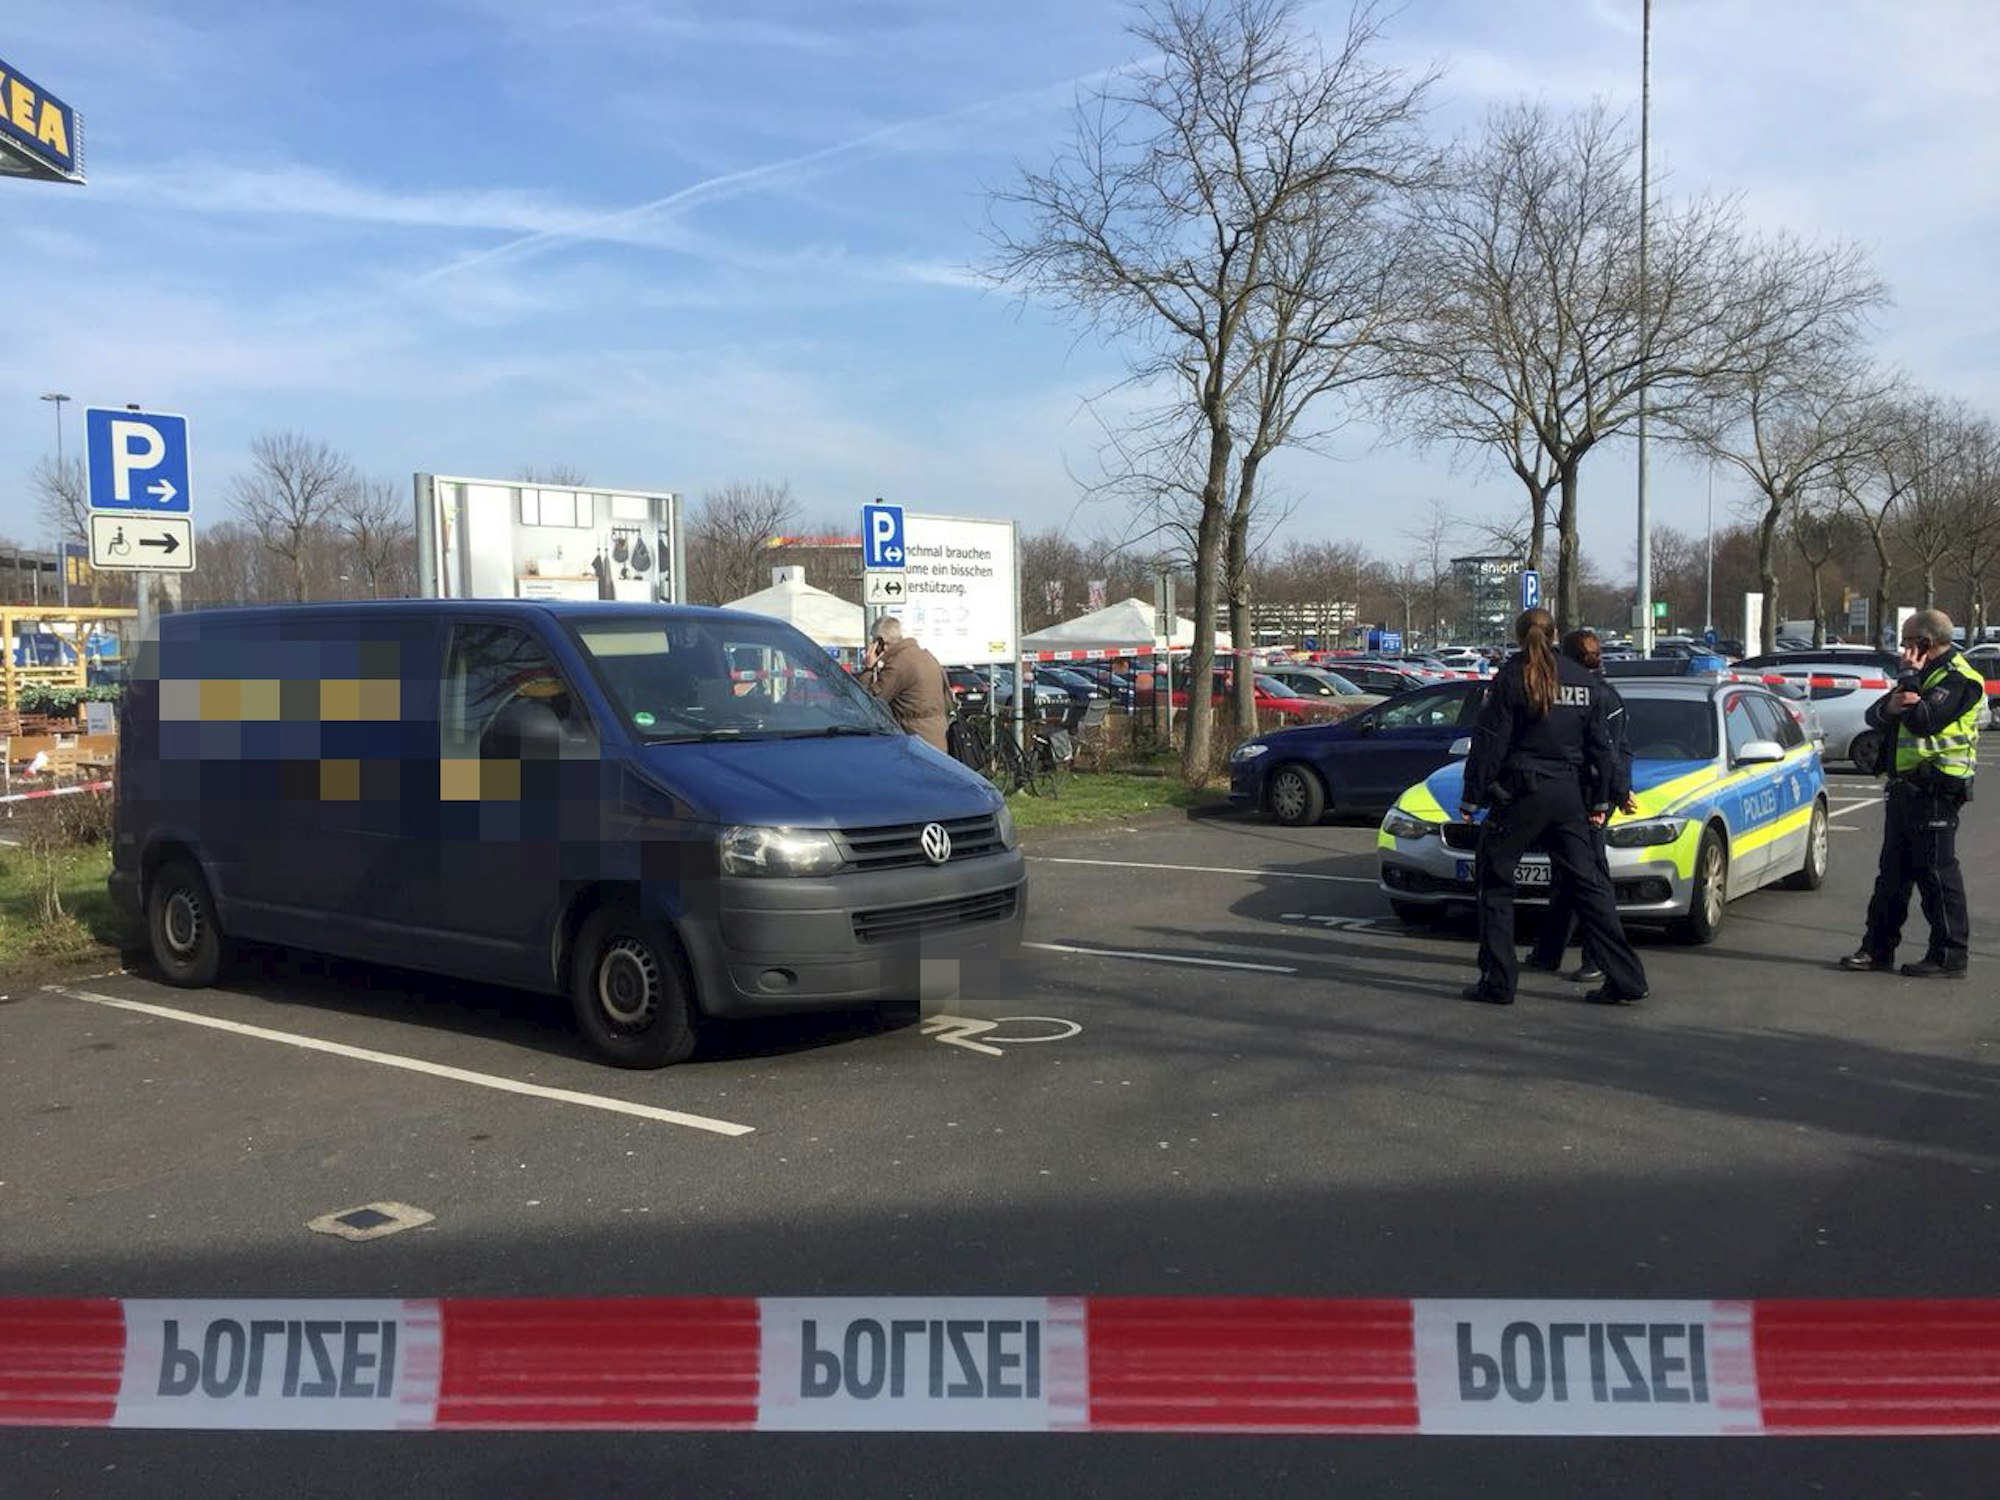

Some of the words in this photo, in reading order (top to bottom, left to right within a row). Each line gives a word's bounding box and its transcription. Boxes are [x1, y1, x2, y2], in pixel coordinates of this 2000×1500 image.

[112, 419, 165, 501] P
[873, 511, 895, 562] P
[945, 545, 992, 560] brauchen
[932, 563, 949, 575] ein
[951, 564, 993, 577] bisschen
[1527, 575, 1537, 606] P
[1742, 788, 1777, 825] POLIZEI
